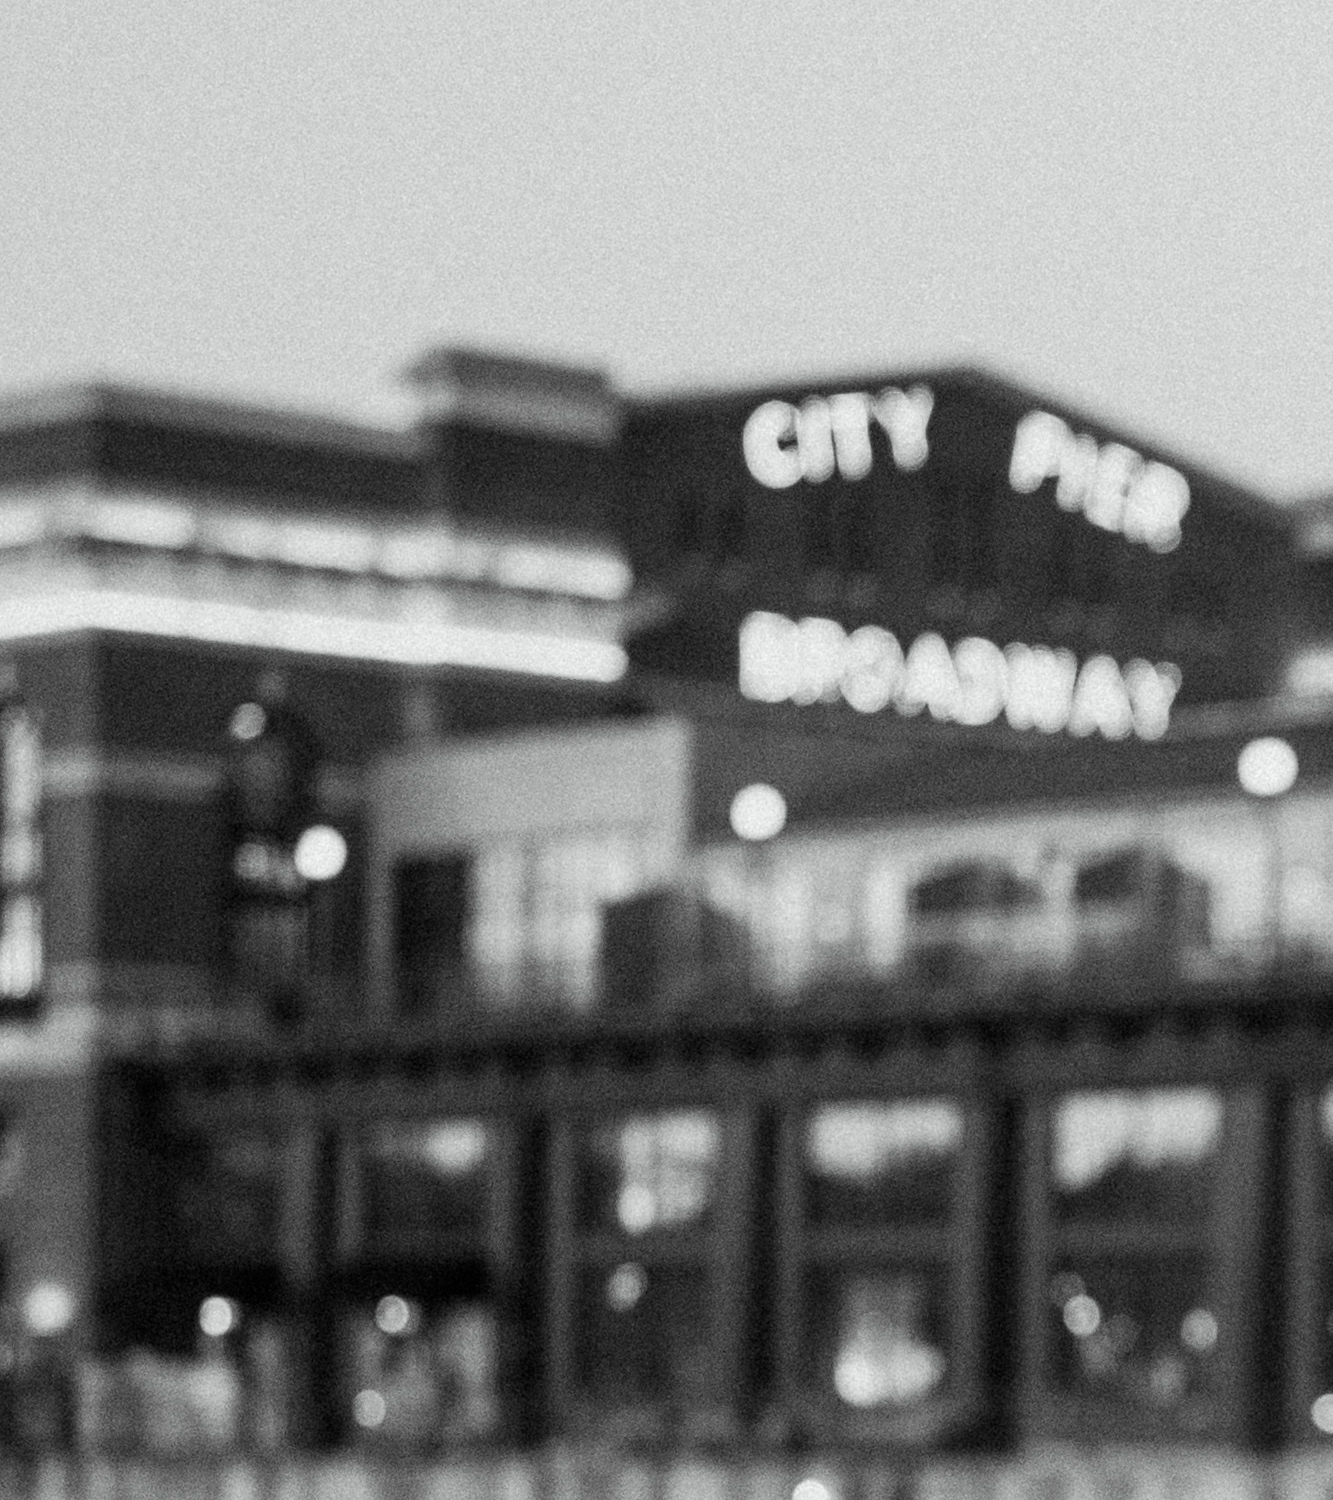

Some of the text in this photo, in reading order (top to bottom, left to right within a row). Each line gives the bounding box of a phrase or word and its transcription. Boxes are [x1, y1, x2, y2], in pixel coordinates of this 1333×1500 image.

[743, 386, 1191, 553] CITY PIER
[738, 610, 1182, 741] BROADWAY
